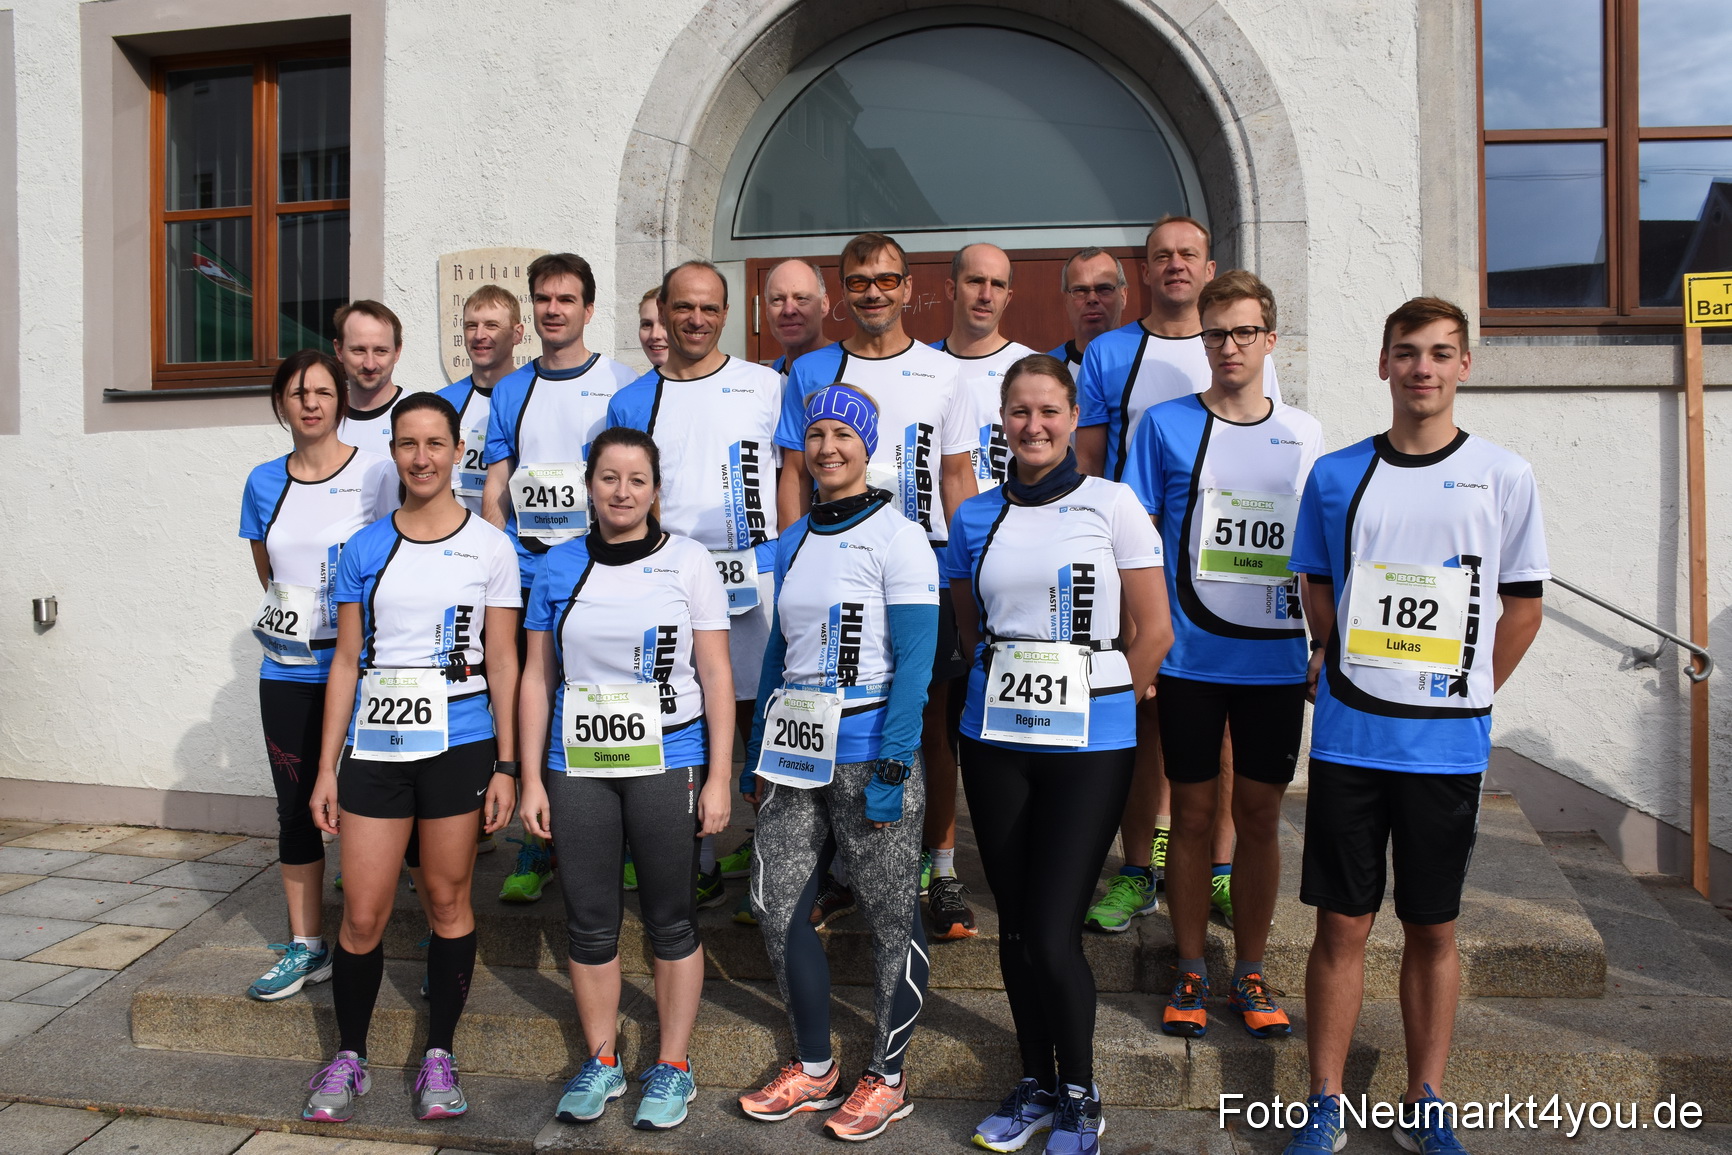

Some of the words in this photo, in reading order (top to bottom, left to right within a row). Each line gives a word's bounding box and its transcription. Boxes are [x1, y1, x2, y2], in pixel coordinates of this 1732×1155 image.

[1723, 283, 1732, 294] T
[906, 445, 916, 520] TECHNOLOG
[522, 485, 575, 507] 2413
[1241, 499, 1274, 509] BOCK
[721, 464, 729, 489] WASTE
[726, 520, 734, 549] Solutions
[732, 463, 748, 549] TECHNOLOGY
[534, 515, 568, 525] Christoph
[1215, 518, 1285, 550] 5108
[1233, 556, 1263, 569] Lukas
[1397, 573, 1437, 585] BOCK
[257, 605, 299, 636] 2422
[1379, 595, 1439, 630] 182
[1386, 638, 1421, 652] Lukas
[826, 624, 838, 687] TECHNOLOG
[1023, 652, 1059, 661] BOCK
[999, 672, 1068, 705] 2431
[367, 697, 432, 724] 2226
[789, 699, 815, 709] BOCK
[575, 713, 646, 742] 5066
[1016, 714, 1051, 728] Regina
[390, 735, 404, 745] Evi
[774, 718, 824, 752] 2065
[594, 751, 631, 762] Simone
[778, 757, 815, 772] Franziska
